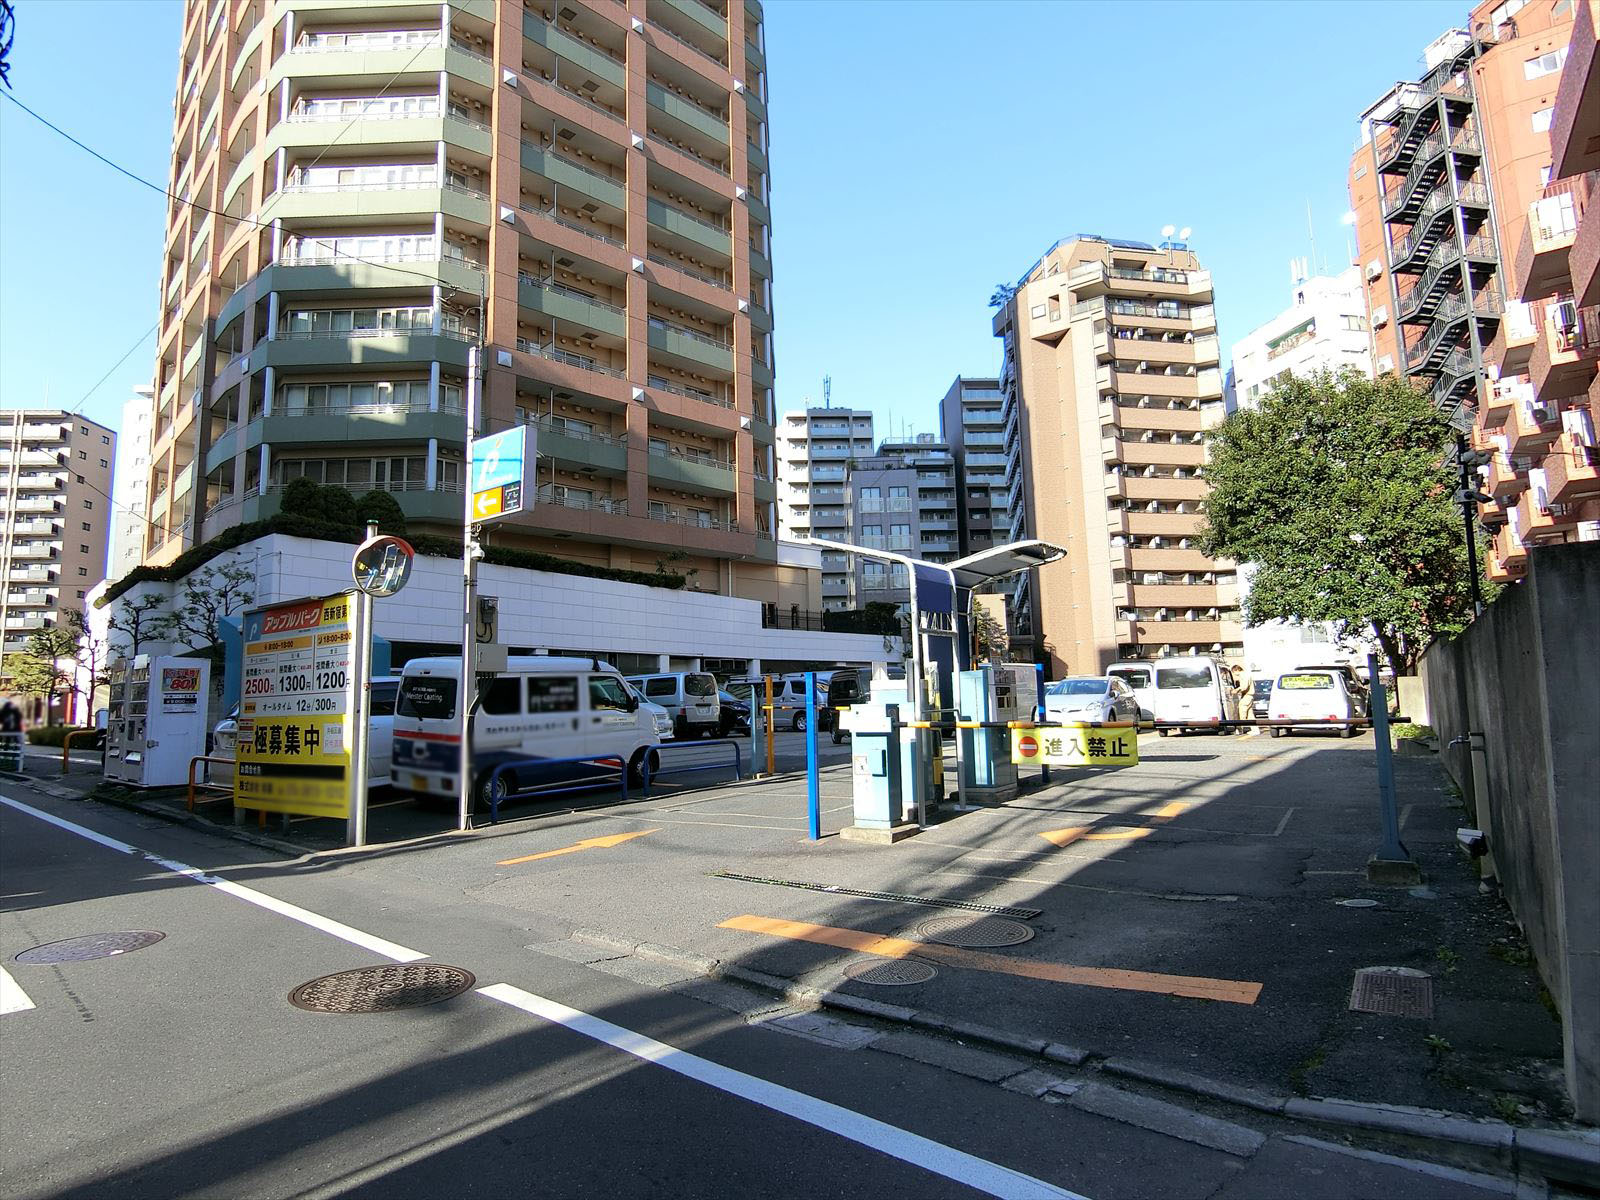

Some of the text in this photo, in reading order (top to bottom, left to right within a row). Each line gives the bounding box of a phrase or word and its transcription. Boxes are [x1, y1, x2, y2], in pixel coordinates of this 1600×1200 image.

[505, 484, 520, 511] 空
[323, 604, 351, 621] 西新宿第
[245, 678, 275, 695] 2500円
[279, 674, 312, 692] 1300円
[316, 671, 351, 690] 1200円
[1045, 736, 1130, 758] 進入禁止
